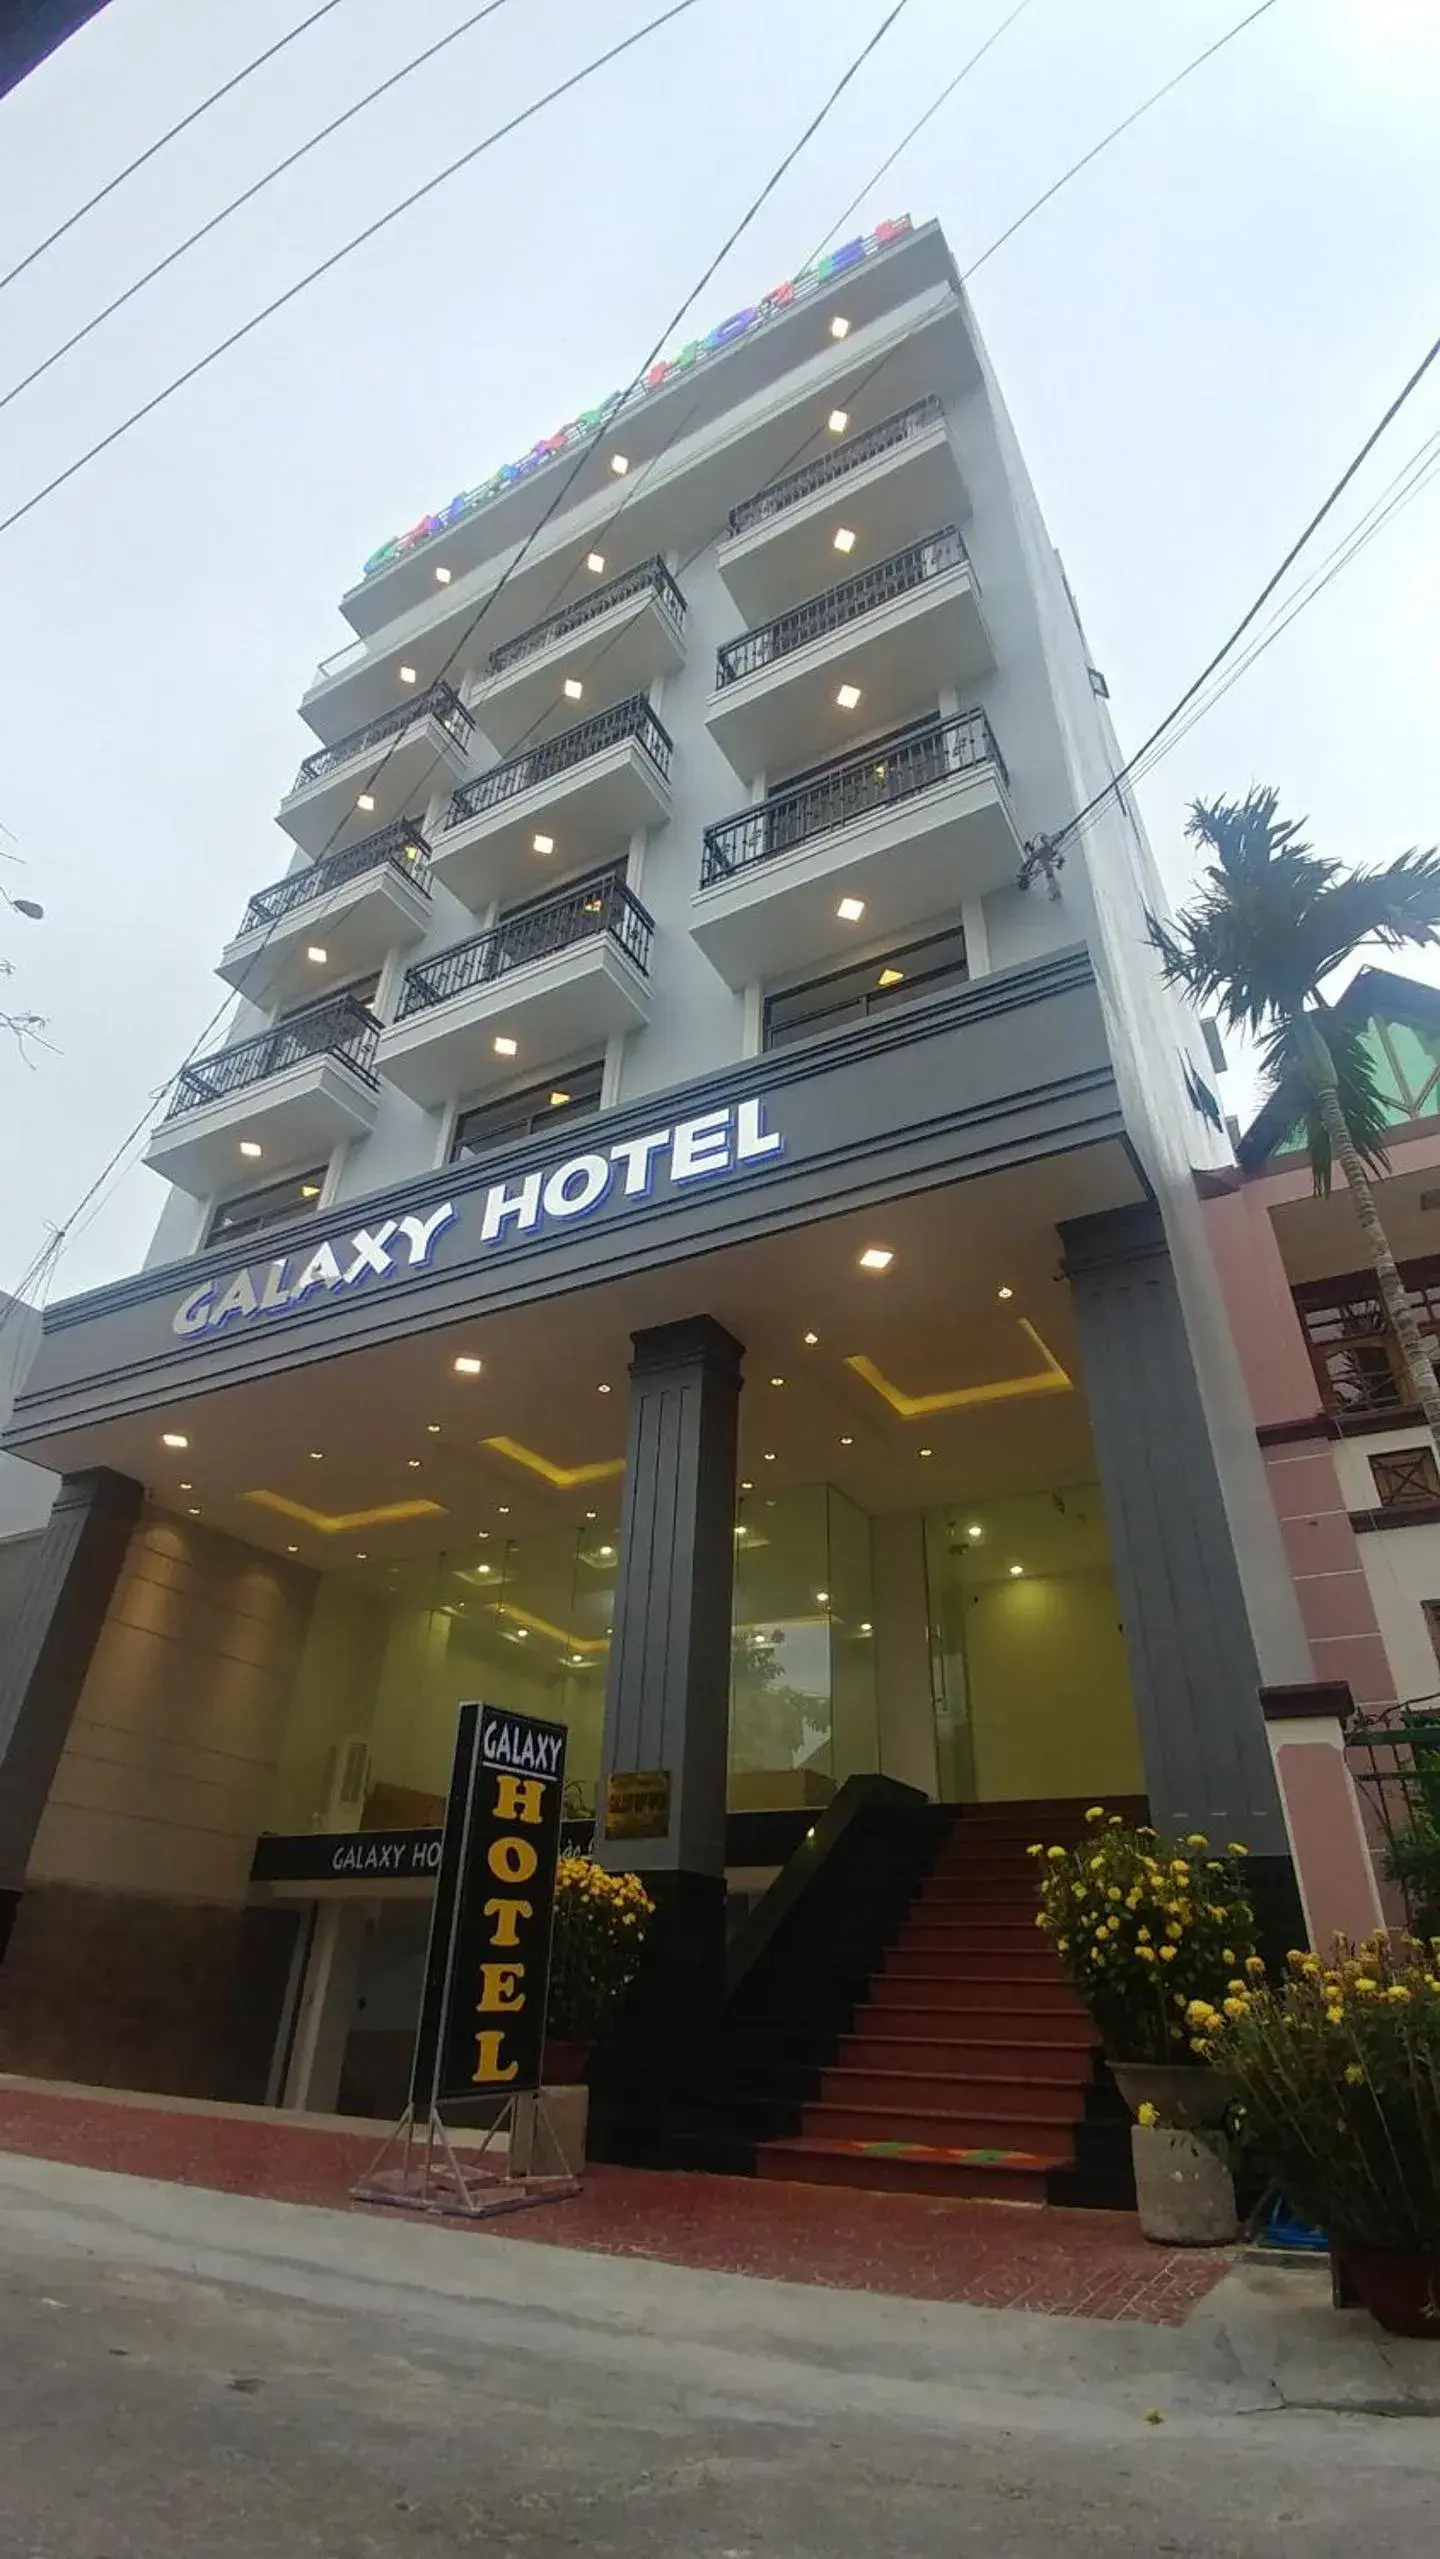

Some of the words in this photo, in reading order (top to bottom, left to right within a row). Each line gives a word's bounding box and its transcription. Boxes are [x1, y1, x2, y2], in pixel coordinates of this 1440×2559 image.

[171, 1202, 458, 1338] GALAXY
[480, 1099, 784, 1246] HOTEL
[483, 1720, 562, 1772] GALAXY
[332, 1843, 406, 1870] GALAXY
[411, 1841, 442, 1868] HO
[473, 1776, 545, 2082] HOTEL
